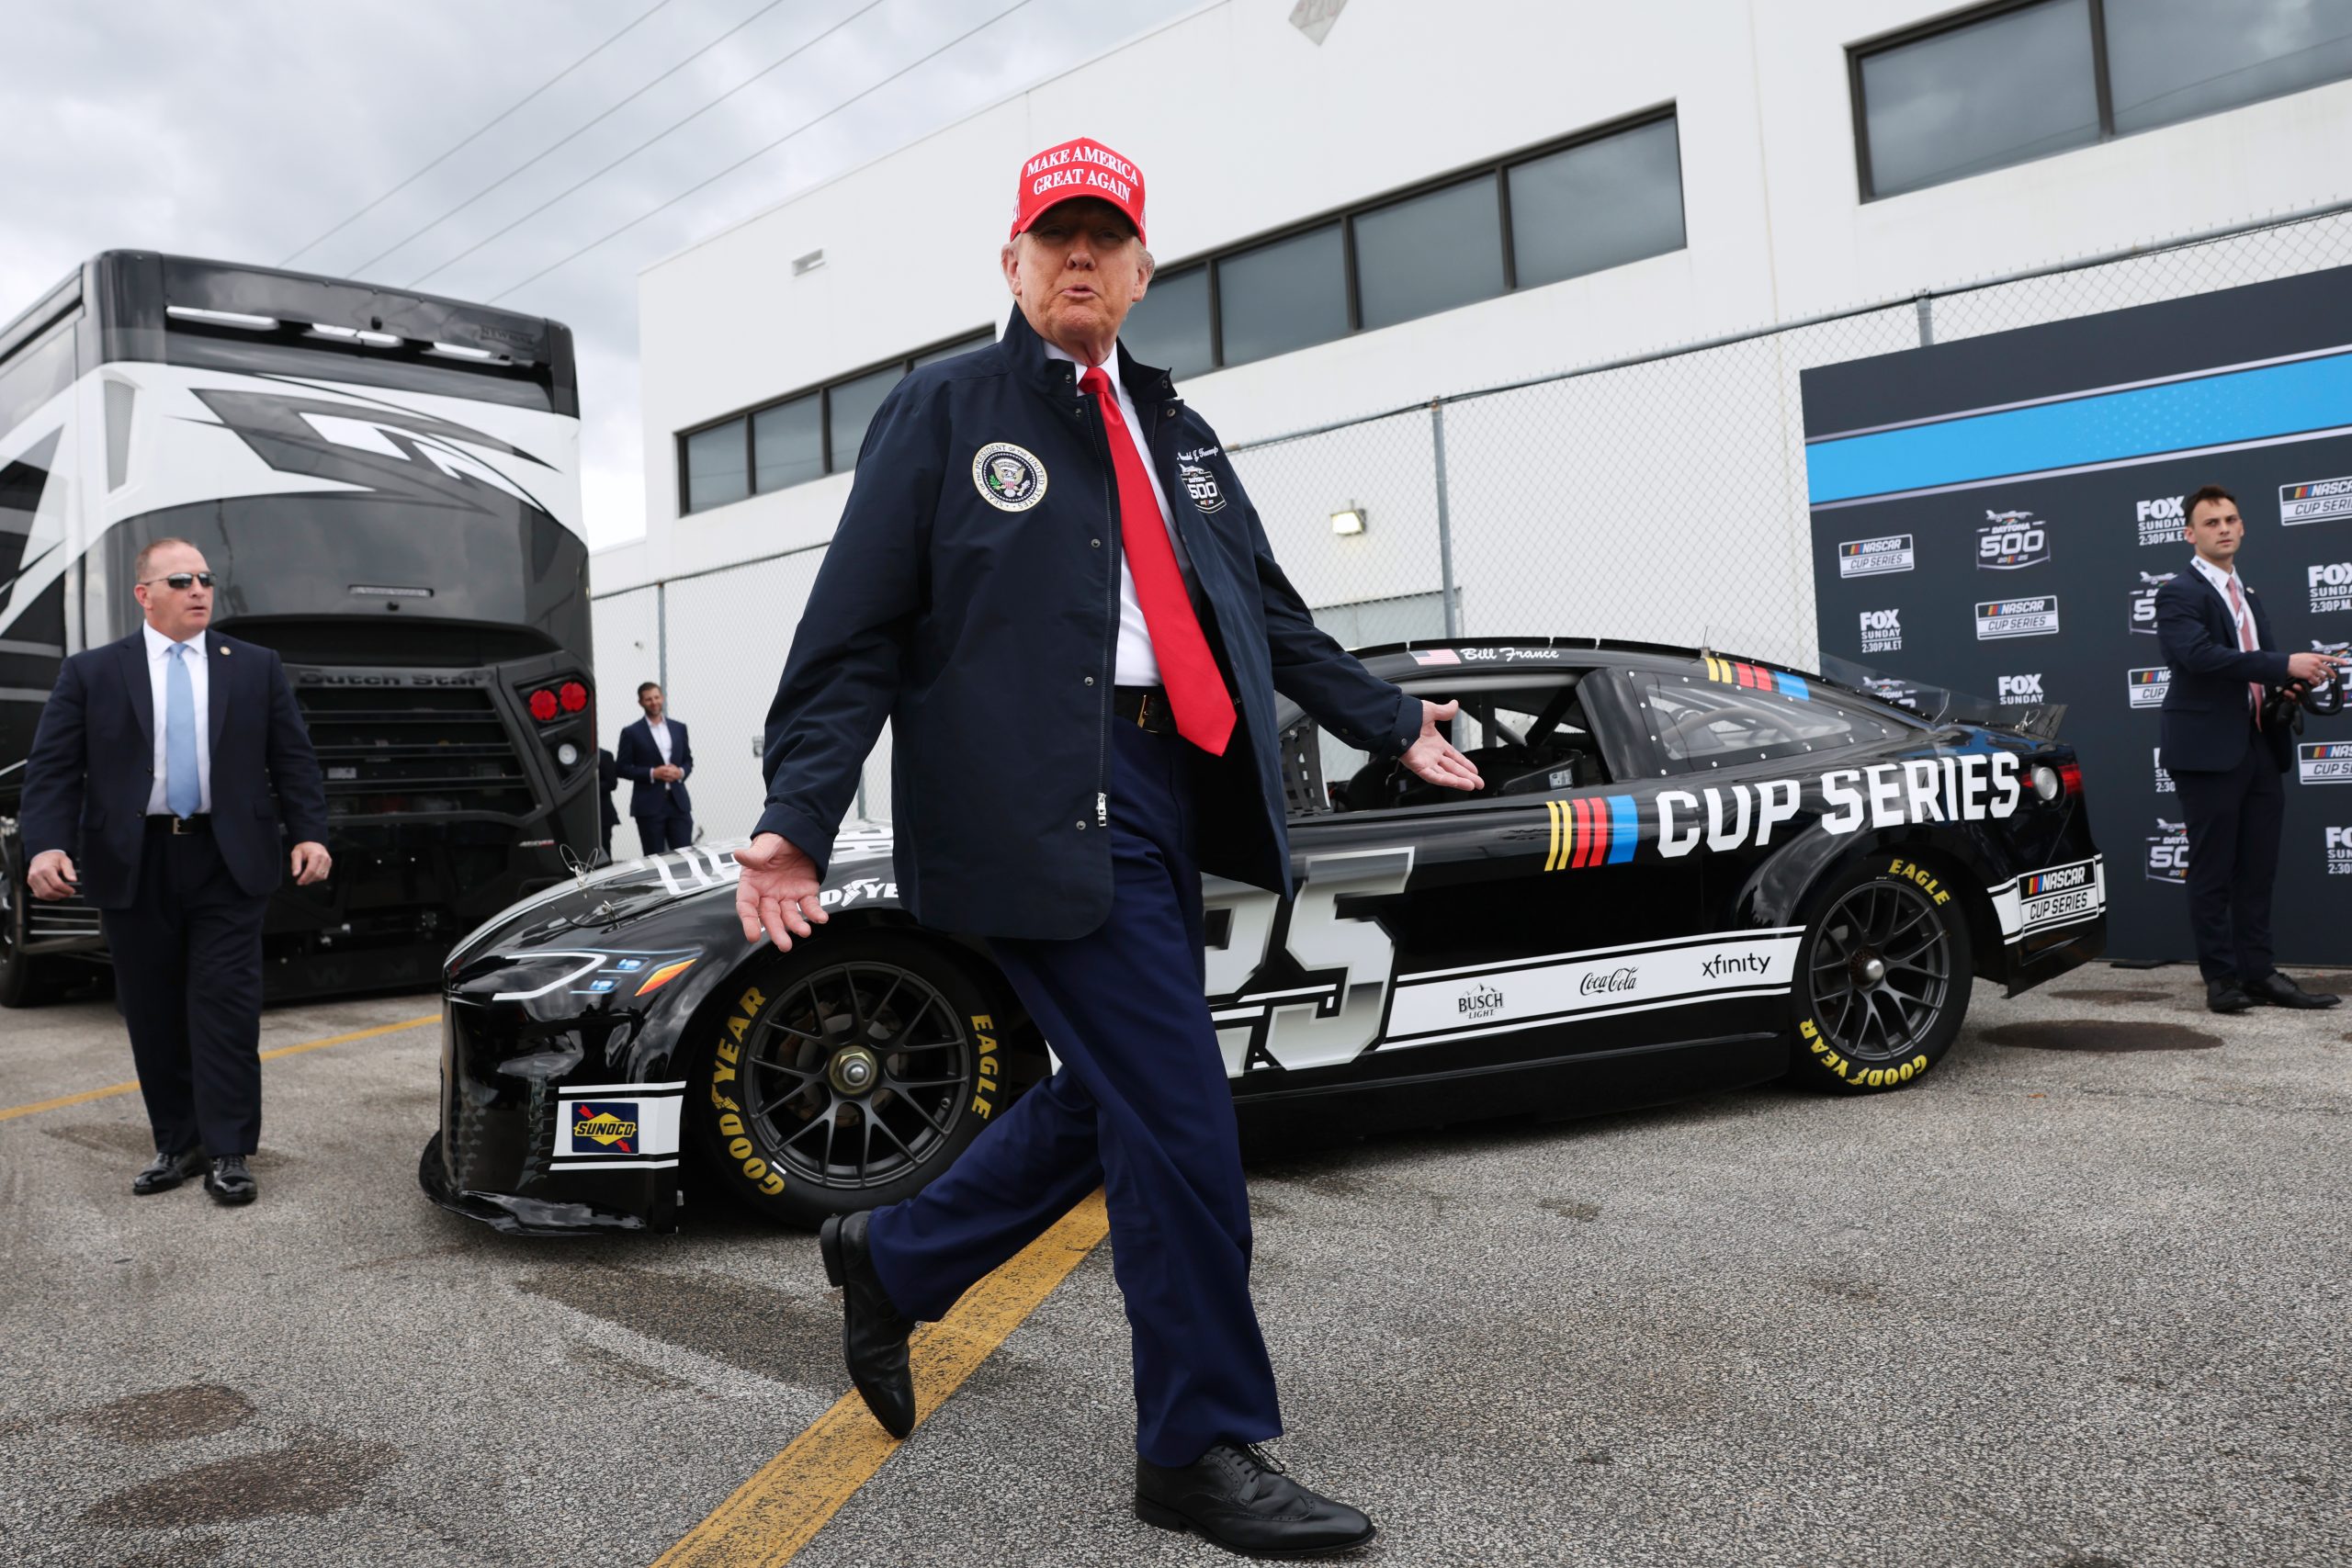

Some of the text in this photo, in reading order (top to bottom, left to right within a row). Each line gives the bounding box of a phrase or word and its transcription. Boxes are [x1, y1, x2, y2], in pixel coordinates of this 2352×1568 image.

[1026, 146, 1138, 186] MAKE AMERICA
[1033, 168, 1131, 204] GREAT AGAIN
[976, 445, 1006, 469] PRESIDENT
[1017, 449, 1028, 457] THE
[1028, 456, 1045, 485] UNITED
[1018, 488, 1043, 509] STATES
[1187, 481, 1218, 499] 500
[2312, 480, 2352, 497] NASCA
[2136, 496, 2185, 522] FOX
[2295, 497, 2352, 515] CUP SERI
[1992, 523, 2030, 534] DAYTONA
[2138, 517, 2187, 532] SUNDAY
[1862, 538, 1902, 553] NASCAR
[1980, 530, 2045, 558] 500
[1850, 554, 1903, 569] CUP SERIES
[2001, 600, 2044, 615] NASCAR
[1860, 609, 1900, 630] FOX
[1988, 616, 2046, 631] CUP SERIES
[1861, 627, 1901, 639] SUNDAY
[1460, 648, 1560, 661] Bill France
[299, 671, 478, 686] Dutch Star
[1997, 673, 2043, 695] FOX
[1999, 694, 2044, 705] SUNDAY
[2142, 687, 2165, 699] CUP
[2313, 763, 2339, 775] CUP
[1656, 751, 2020, 858] CUP SERIES
[2150, 845, 2189, 867] 50
[1889, 859, 1951, 906] EAGLE
[2041, 866, 2086, 891] NASCAR
[2030, 892, 2087, 919] CUP SERIES
[1702, 953, 1771, 979] xfinity
[1458, 992, 1504, 1013] BUSCH
[1468, 1009, 1495, 1020] LIGHT
[1799, 1019, 1928, 1087] GOODYEAR
[970, 1014, 1000, 1120] EAGLE
[711, 987, 786, 1194] GOODYEAR
[577, 1122, 635, 1137] SUNOCO
